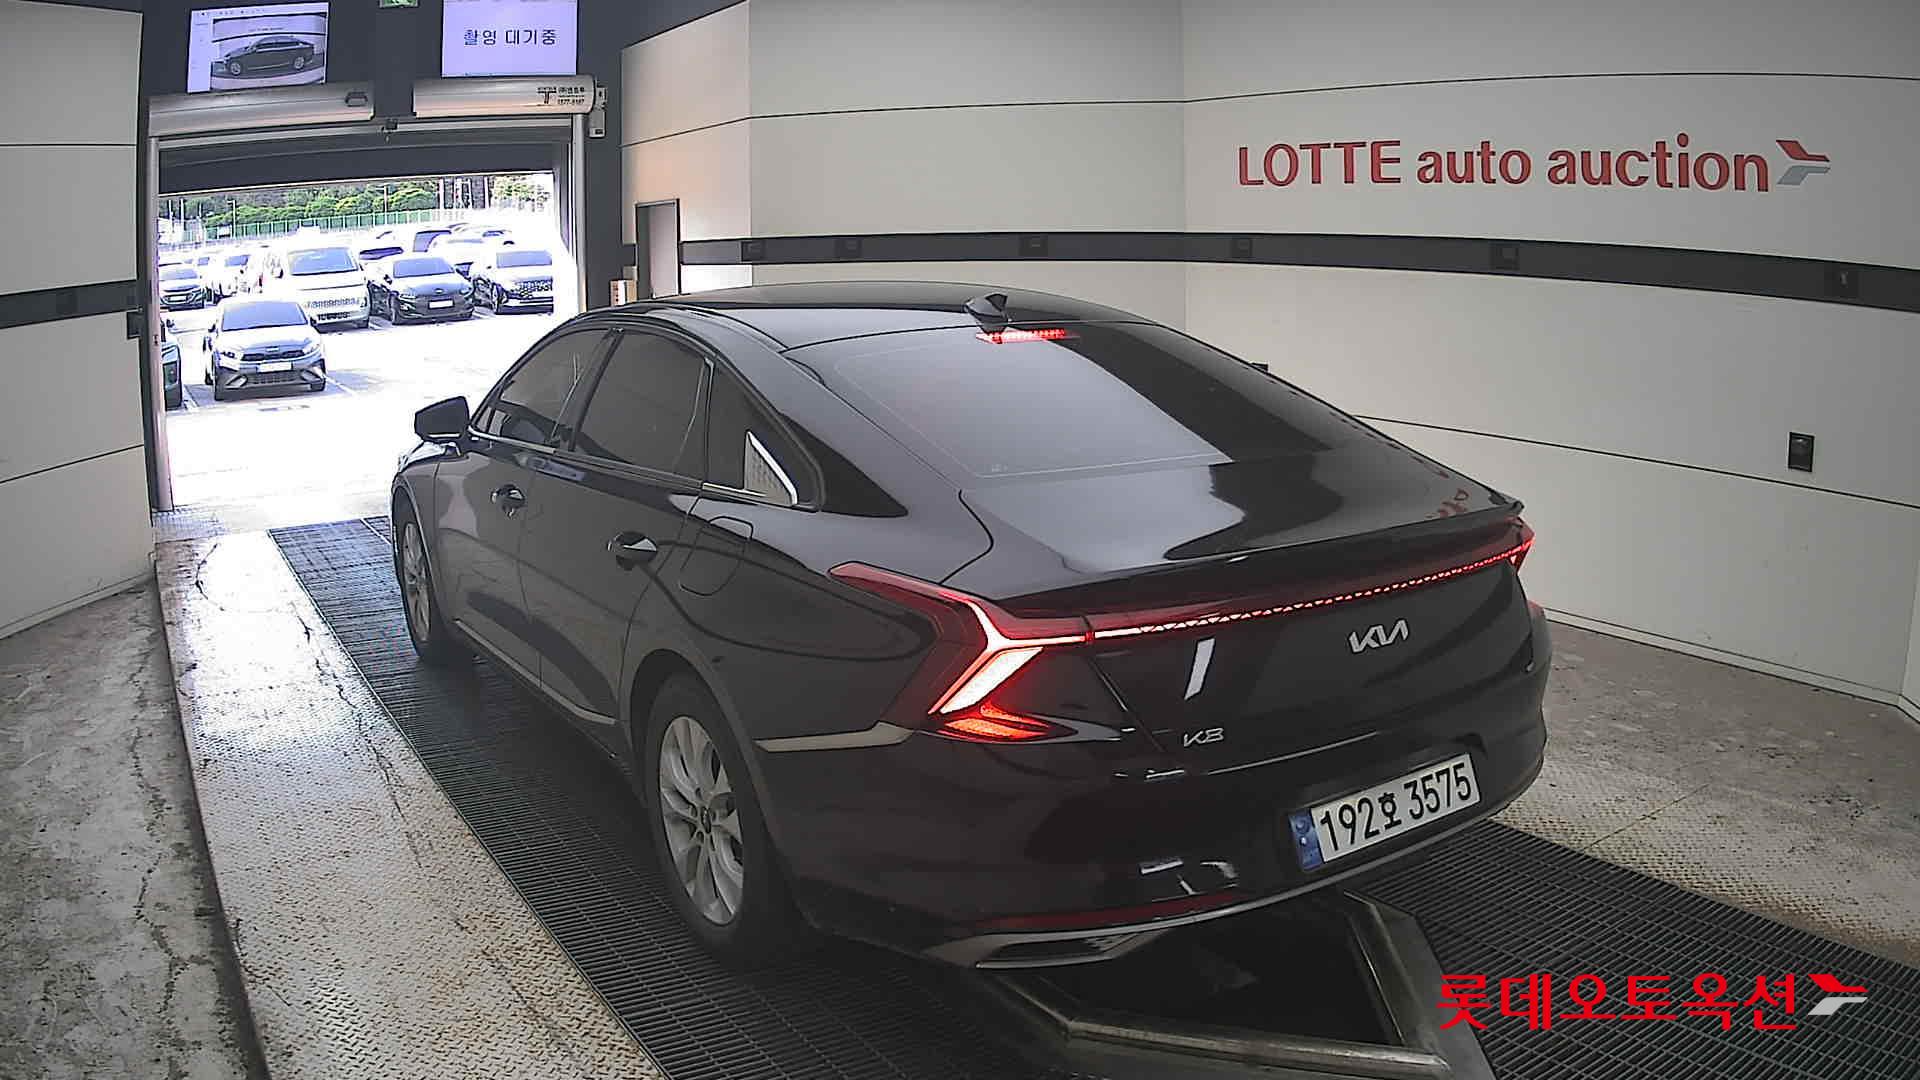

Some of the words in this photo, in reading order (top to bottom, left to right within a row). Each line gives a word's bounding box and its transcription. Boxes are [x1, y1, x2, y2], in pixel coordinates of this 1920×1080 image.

[463, 29, 497, 46] 촬영
[504, 29, 556, 46] 대기중
[1238, 140, 1401, 187] LOTTE
[1416, 140, 1532, 185] auto
[1547, 132, 1769, 192] auction
[1320, 792, 1402, 851] 192호
[1403, 762, 1471, 820] 3575
